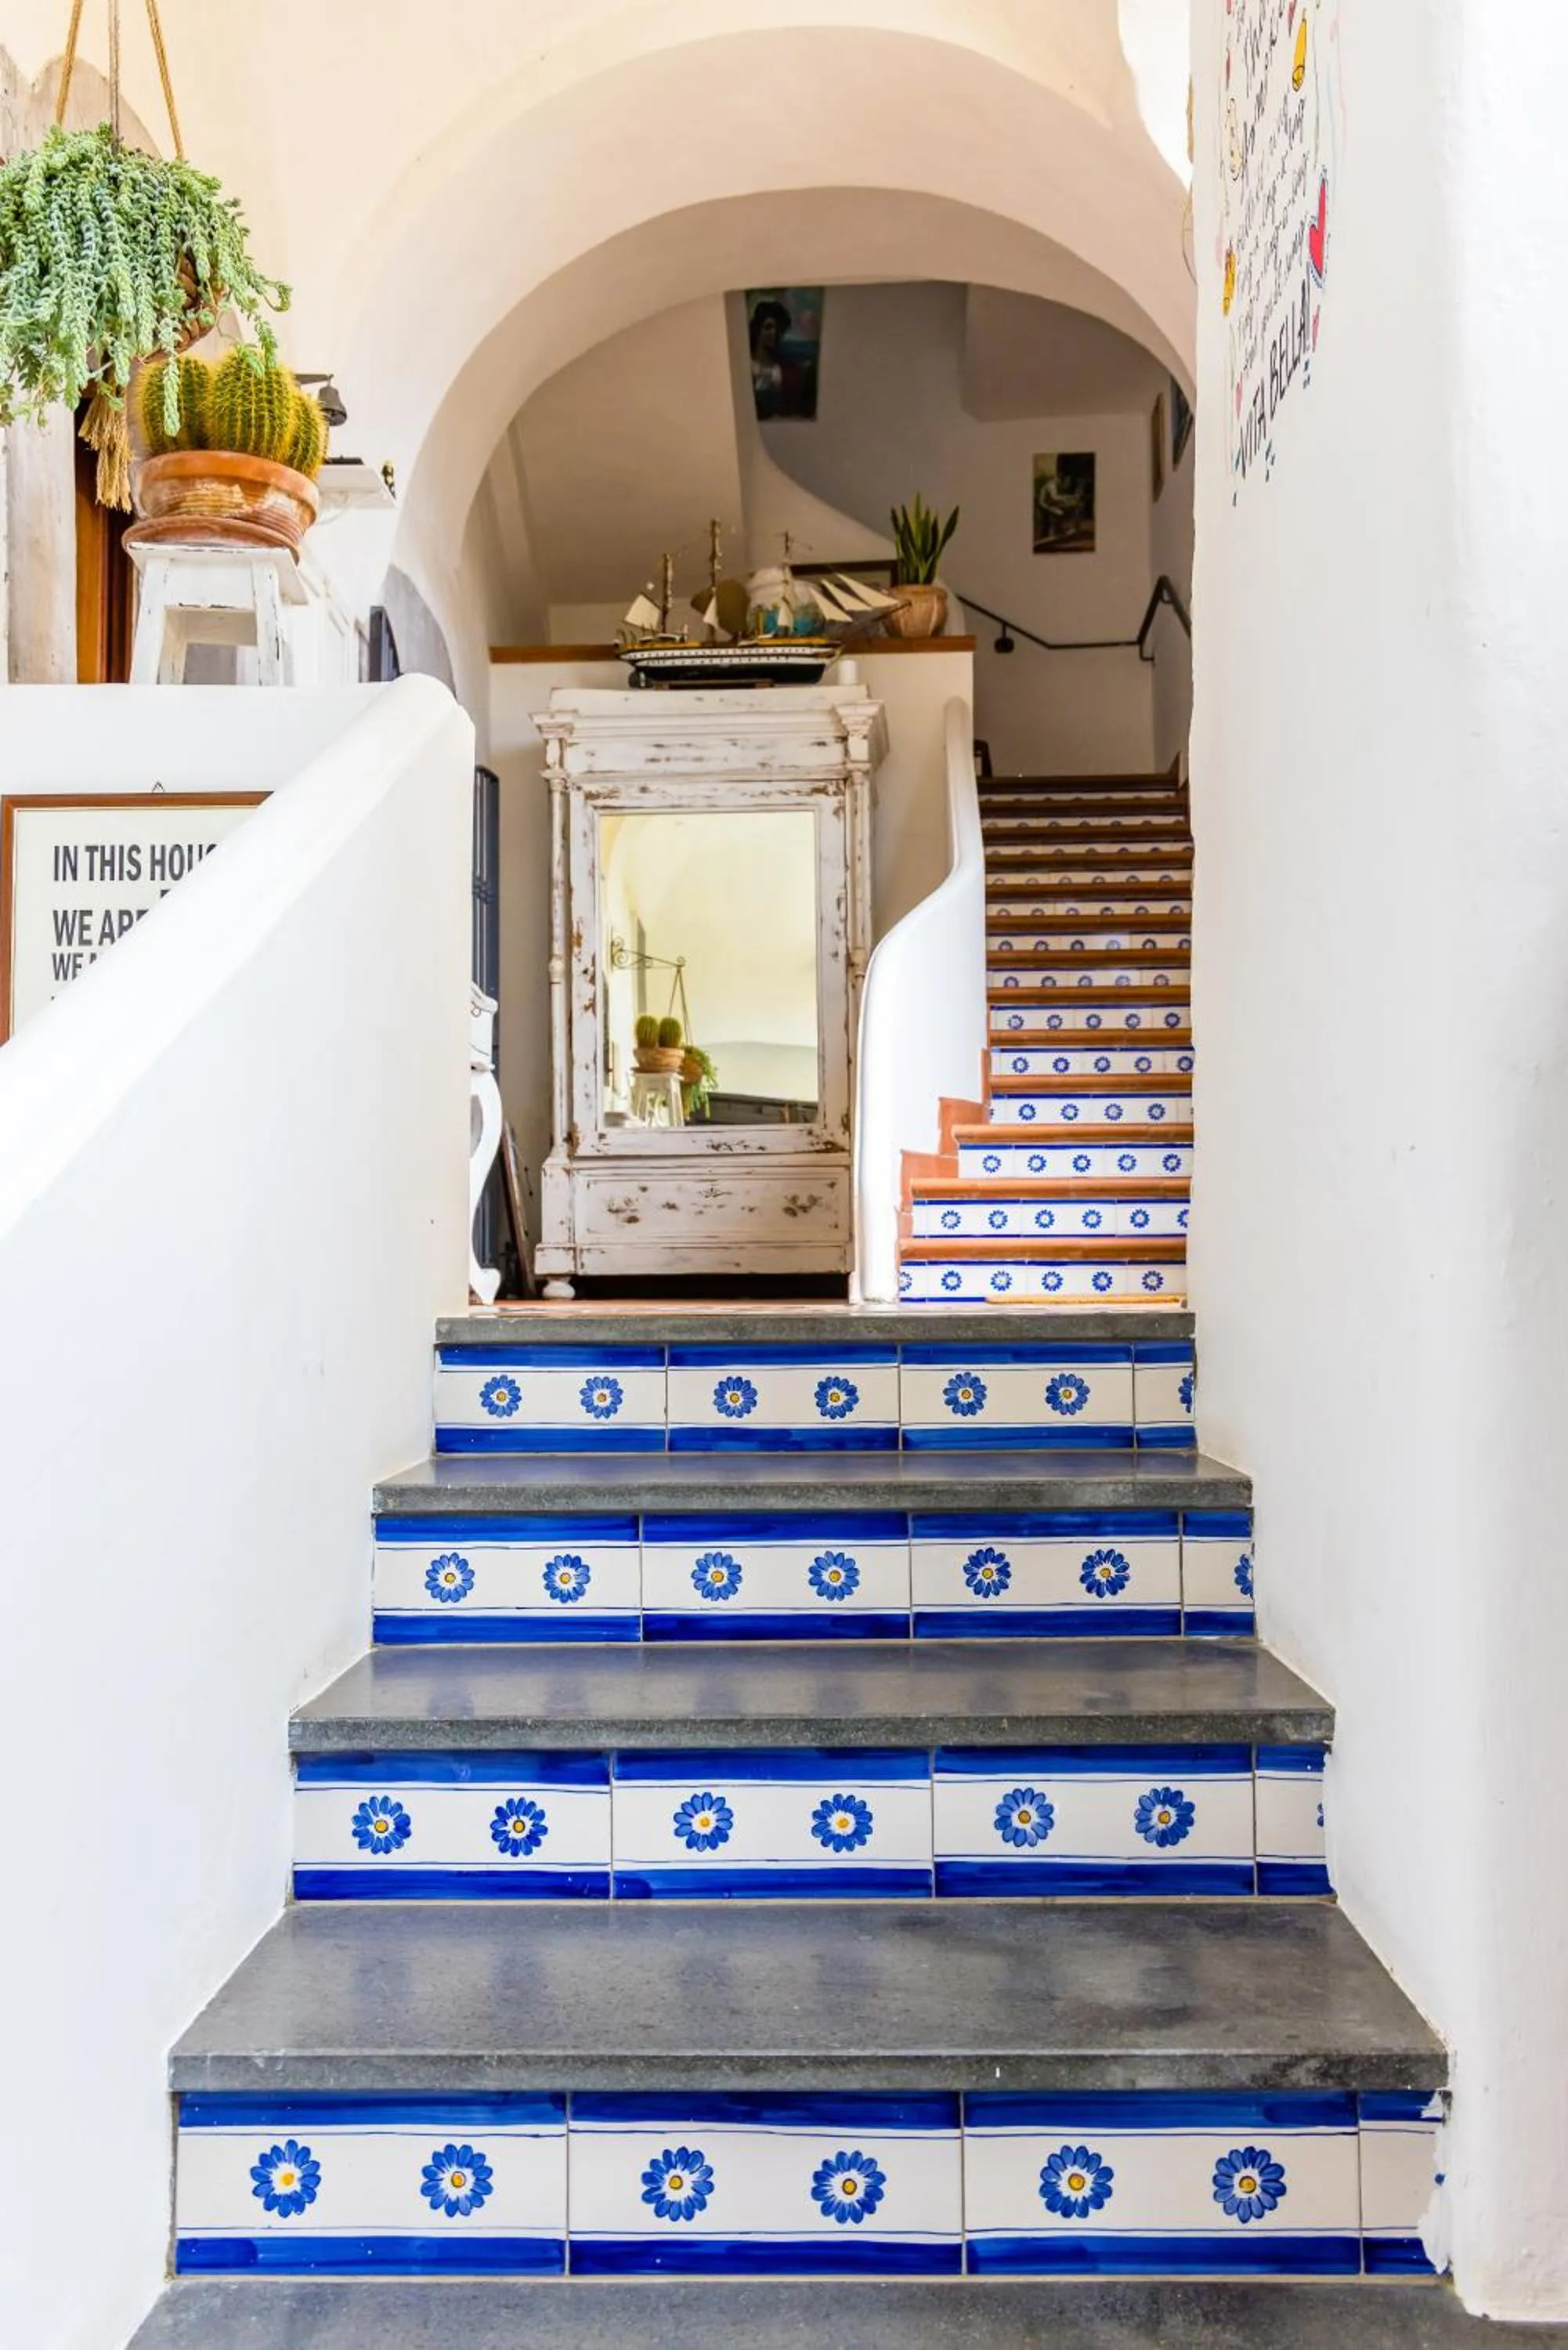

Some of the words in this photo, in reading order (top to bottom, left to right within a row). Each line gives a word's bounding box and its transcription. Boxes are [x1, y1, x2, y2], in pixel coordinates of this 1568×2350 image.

[1239, 376, 1266, 479] VITA
[53, 845, 78, 881] IN
[85, 844, 142, 881] THIS
[150, 844, 218, 881] HOU
[52, 909, 93, 946] WE
[98, 909, 150, 946] AR
[52, 953, 84, 982] WE
